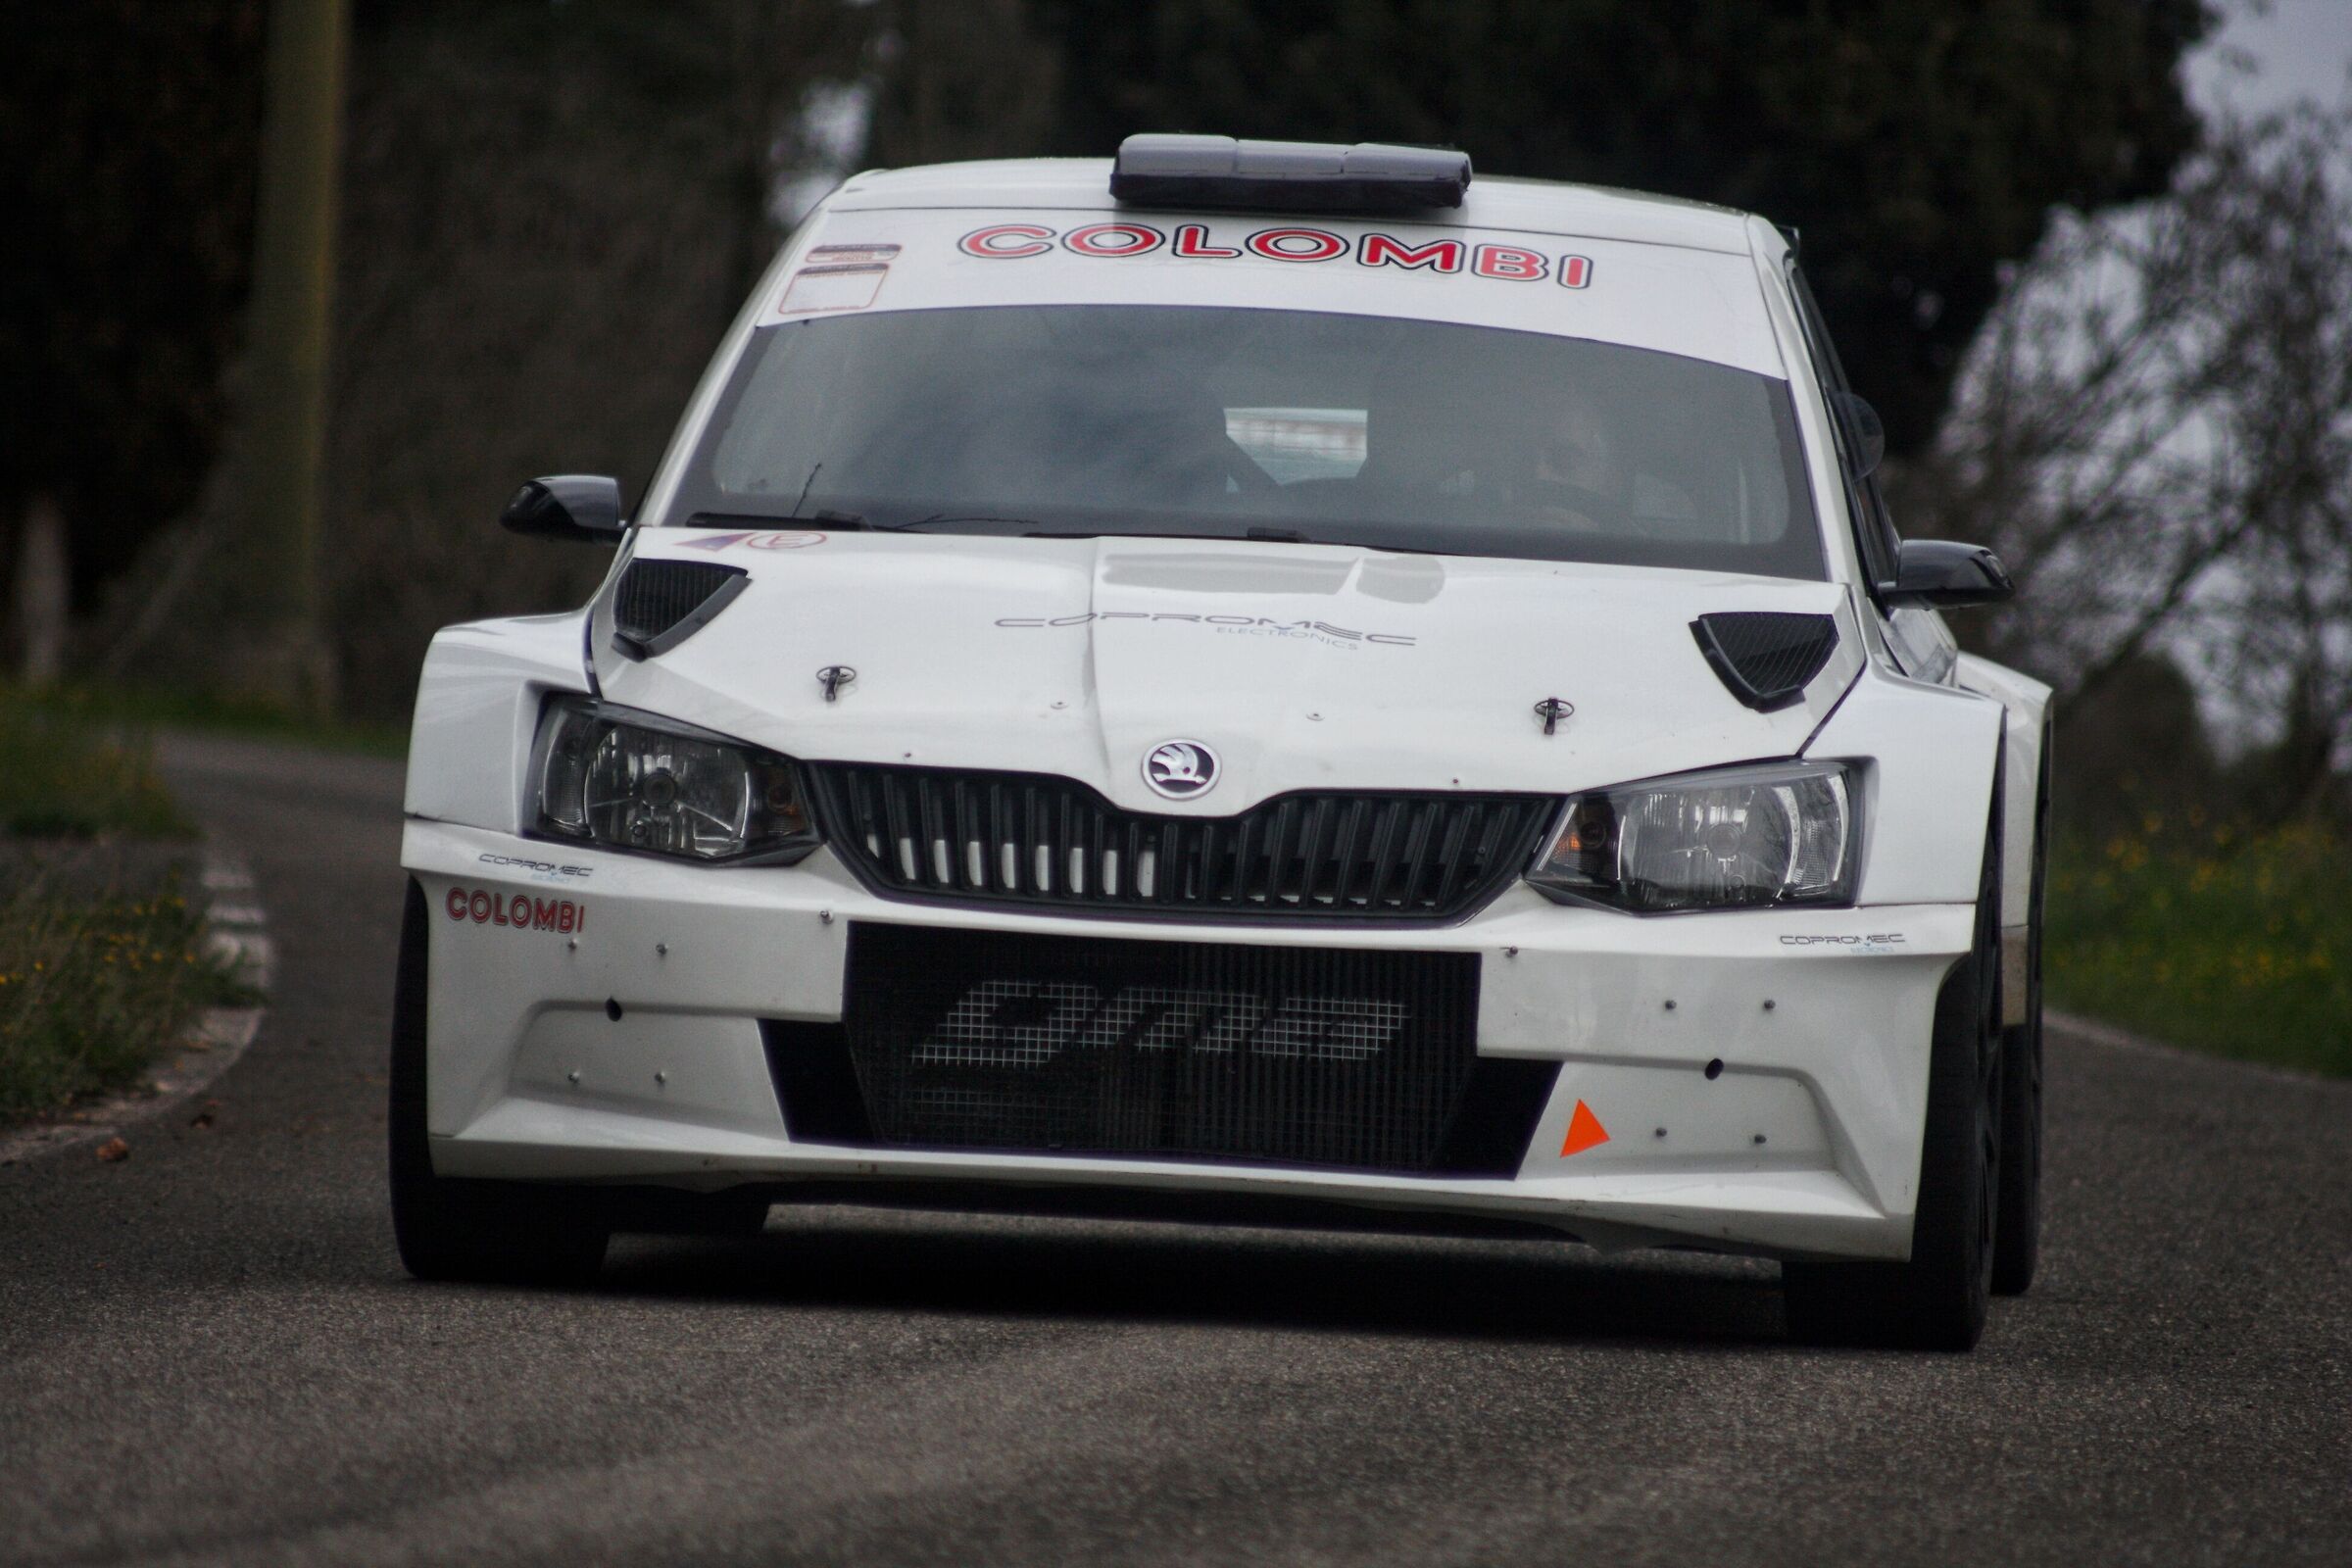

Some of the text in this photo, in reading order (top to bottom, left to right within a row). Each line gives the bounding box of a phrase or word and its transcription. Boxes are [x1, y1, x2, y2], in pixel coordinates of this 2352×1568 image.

[956, 222, 1592, 290] COLOMBI
[994, 612, 1417, 646] COPROMEC
[1216, 625, 1359, 651] ELECTRONICS
[478, 853, 594, 877] COPROMEC
[446, 886, 585, 934] COLOMBI
[1780, 933, 1905, 947] COPROMEC
